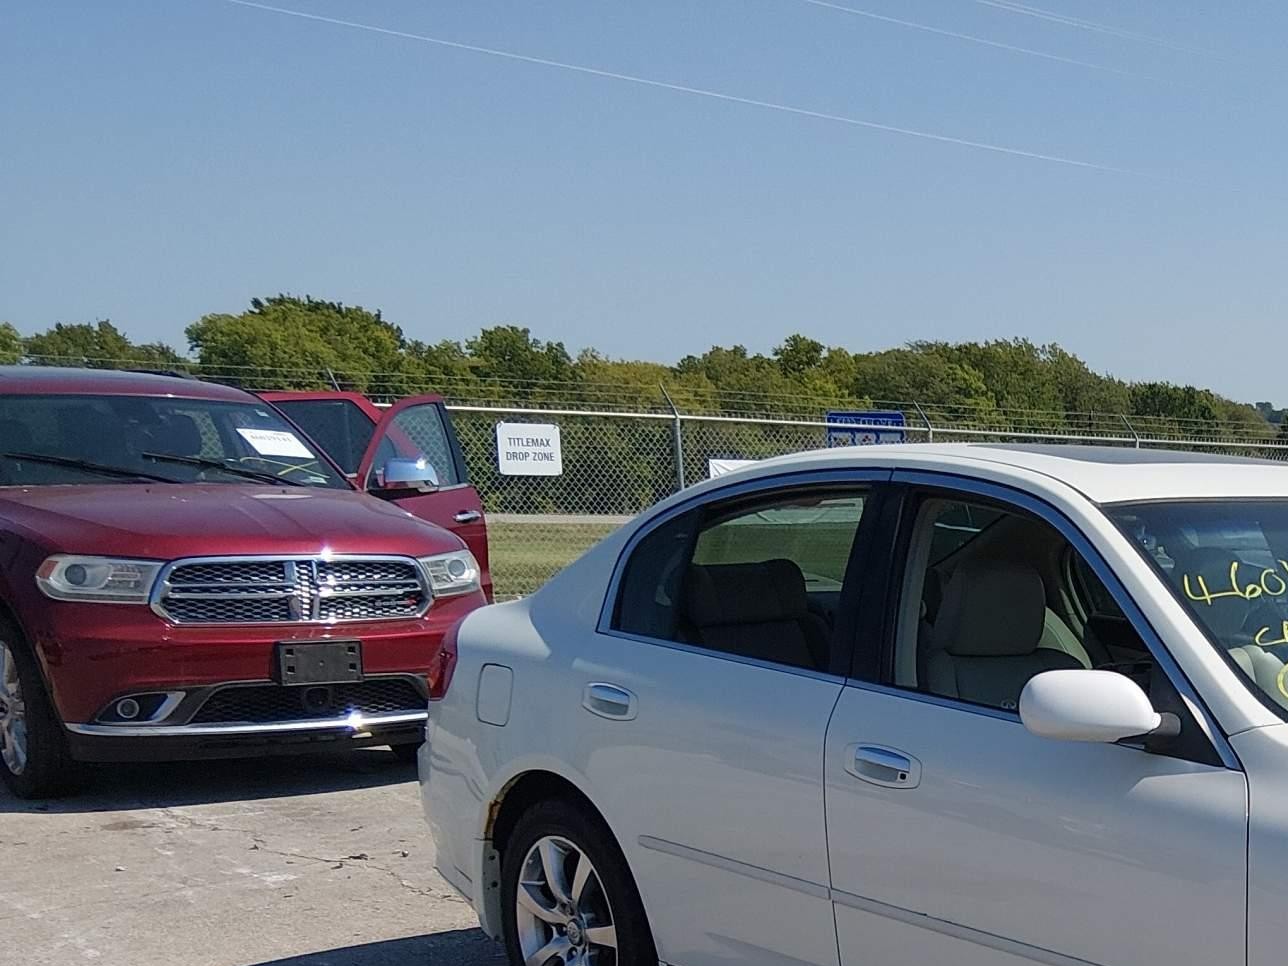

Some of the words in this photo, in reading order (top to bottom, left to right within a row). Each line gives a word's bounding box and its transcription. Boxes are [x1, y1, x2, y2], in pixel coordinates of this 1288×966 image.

[508, 437, 551, 447] TITLEMAX
[506, 451, 530, 461] DROP
[532, 452, 555, 461] ZONE
